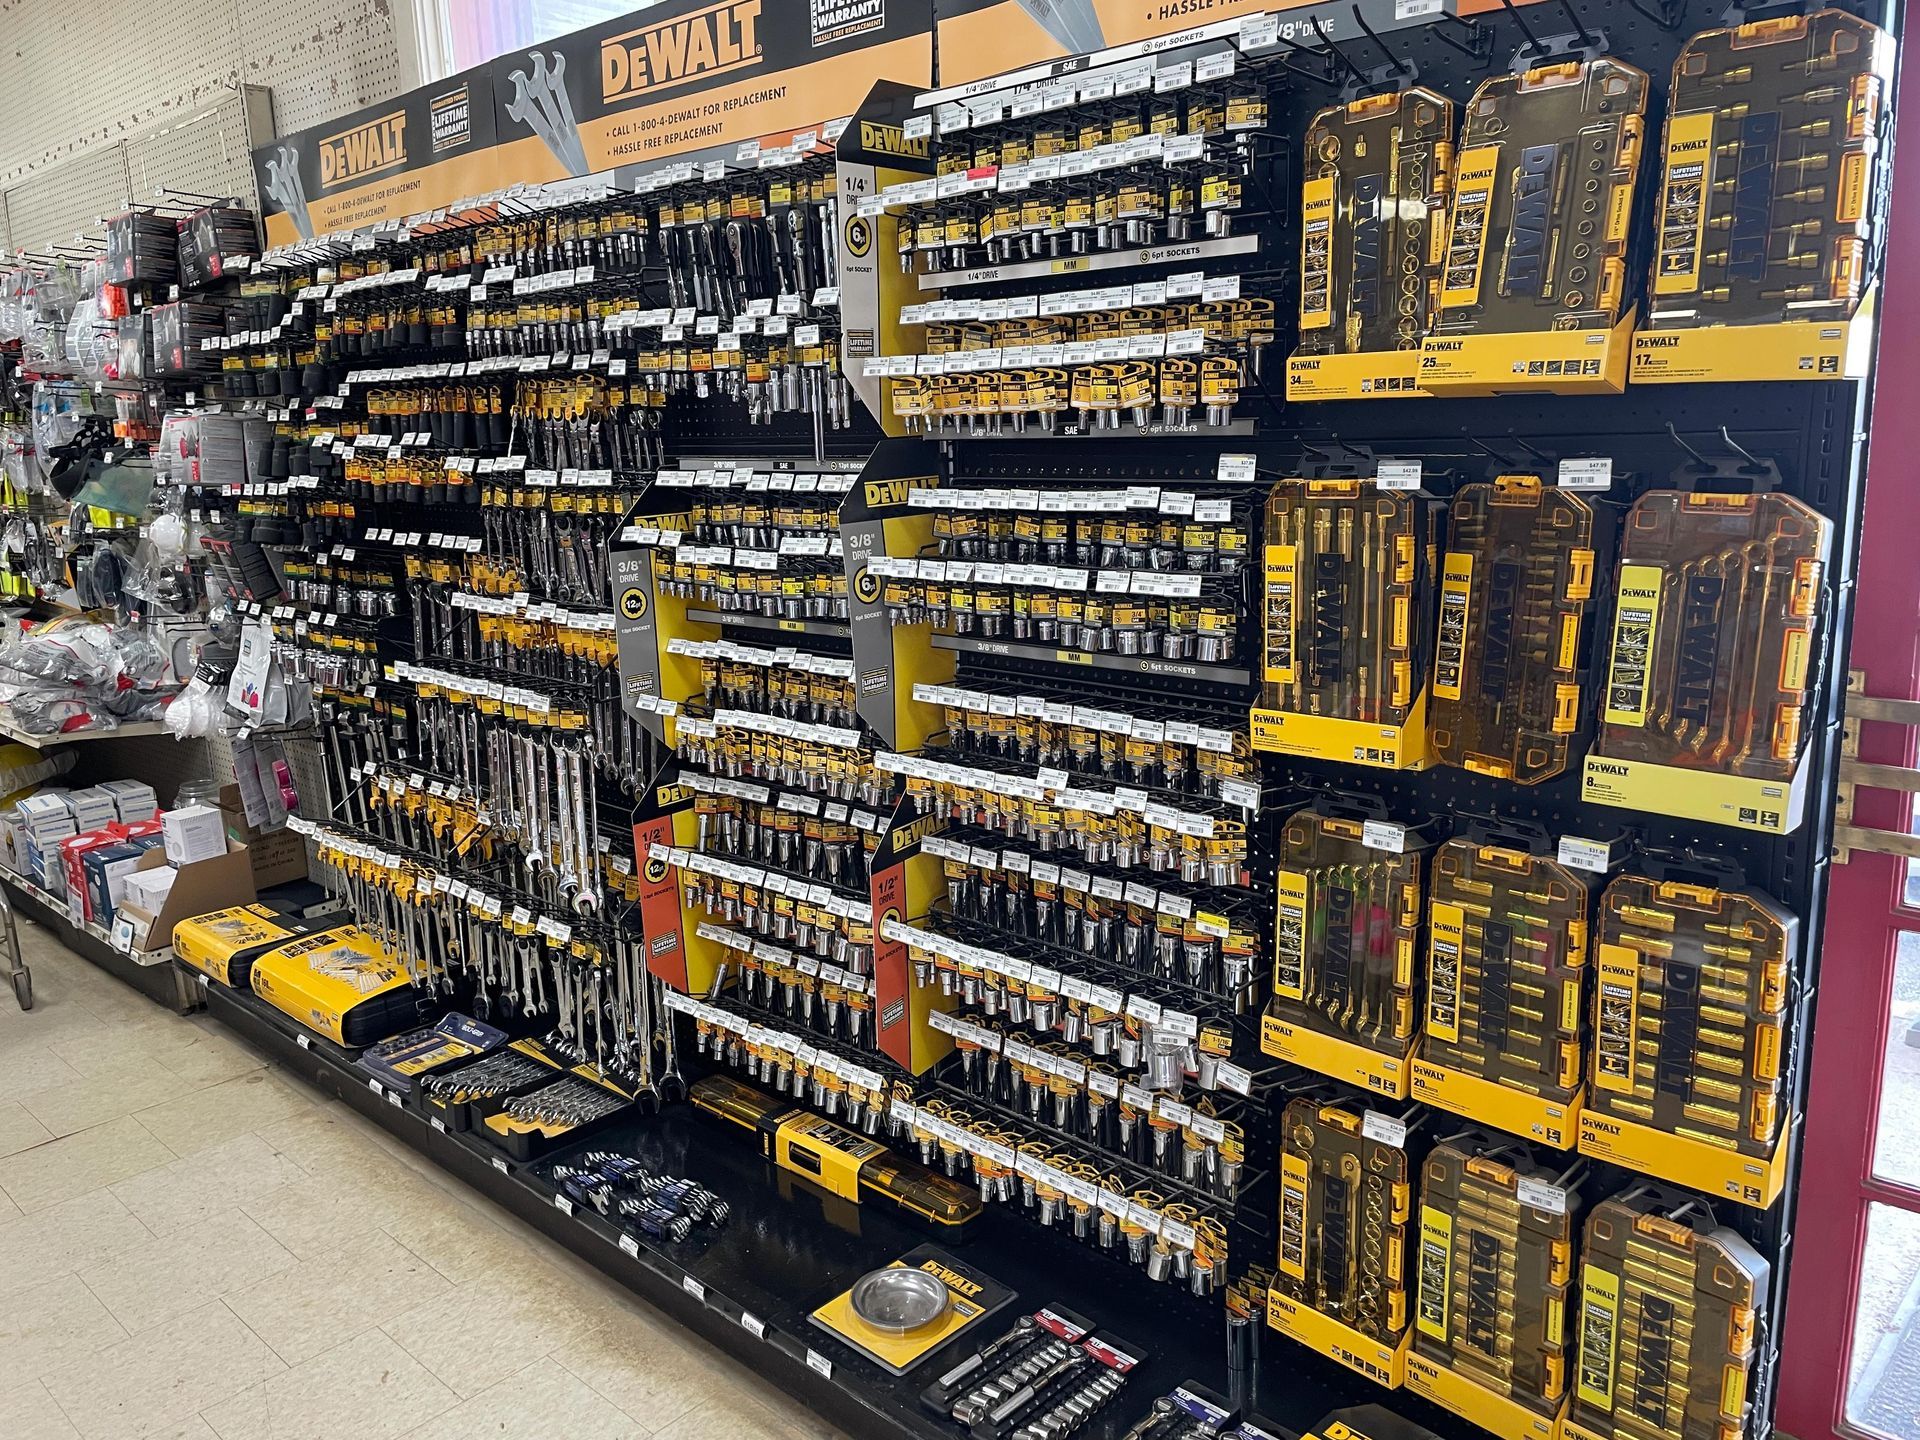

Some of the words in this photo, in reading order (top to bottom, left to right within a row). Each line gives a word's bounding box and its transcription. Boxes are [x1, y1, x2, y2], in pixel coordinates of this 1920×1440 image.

[817, 0, 881, 28] WARRANTY
[1159, 0, 1213, 20] HASSLE
[815, 32, 832, 43] HASSLE
[832, 28, 844, 37] FREE
[845, 19, 881, 34] REPLACEMENT
[1277, 21, 1303, 39] /8"
[1154, 39, 1167, 50] 6pt
[1169, 31, 1204, 45] SOCKETS
[1062, 62, 1077, 72] SAE
[980, 80, 997, 90] DRIVE
[435, 106, 468, 128] LIFETIME
[612, 126, 630, 138] CALL
[633, 107, 701, 133] 1-800-4-DEWALT
[704, 103, 720, 117] FOR
[724, 87, 786, 112] REPLACEMENT
[435, 120, 468, 140] WARRANTY
[613, 141, 641, 156] HASSLE
[644, 136, 661, 150] FREE
[664, 123, 723, 145] REPLACEMENT
[845, 177, 868, 192] 1/4"
[327, 203, 337, 214] CALL
[376, 190, 385, 200] FOR
[386, 180, 421, 197] REPLACEMENT
[328, 217, 343, 228] HASSLE
[344, 214, 354, 224] FREE
[355, 205, 387, 222] REPLACEMENT
[1166, 247, 1201, 258] SOCKETS
[1064, 261, 1077, 270] MM
[967, 272, 981, 281] 1/4"
[982, 270, 999, 280] DRIVE
[1422, 358, 1437, 368] 25
[1635, 354, 1652, 365] 17
[1290, 375, 1302, 385] 34
[1064, 426, 1078, 435] SAE
[850, 533, 875, 548] 3/8"
[618, 560, 642, 573] 3/8"
[620, 573, 639, 584] DRIVE
[863, 611, 883, 621] SOCKET
[978, 642, 992, 651] 3/8"
[992, 645, 1009, 654] DRIVE
[1068, 652, 1081, 662] MM
[1164, 665, 1196, 675] SOCKETS
[1254, 727, 1265, 737] 15
[1586, 777, 1594, 787] 8
[642, 827, 665, 842] 1/2"
[878, 875, 898, 893] 1/2"
[879, 891, 895, 906] DRIVE
[1264, 1032, 1270, 1040] 8
[1414, 1077, 1425, 1088] 20
[1582, 1131, 1595, 1143] 20
[920, 1260, 983, 1297] DEWALT
[1270, 1307, 1280, 1318] 23
[1408, 1369, 1419, 1382] 10
